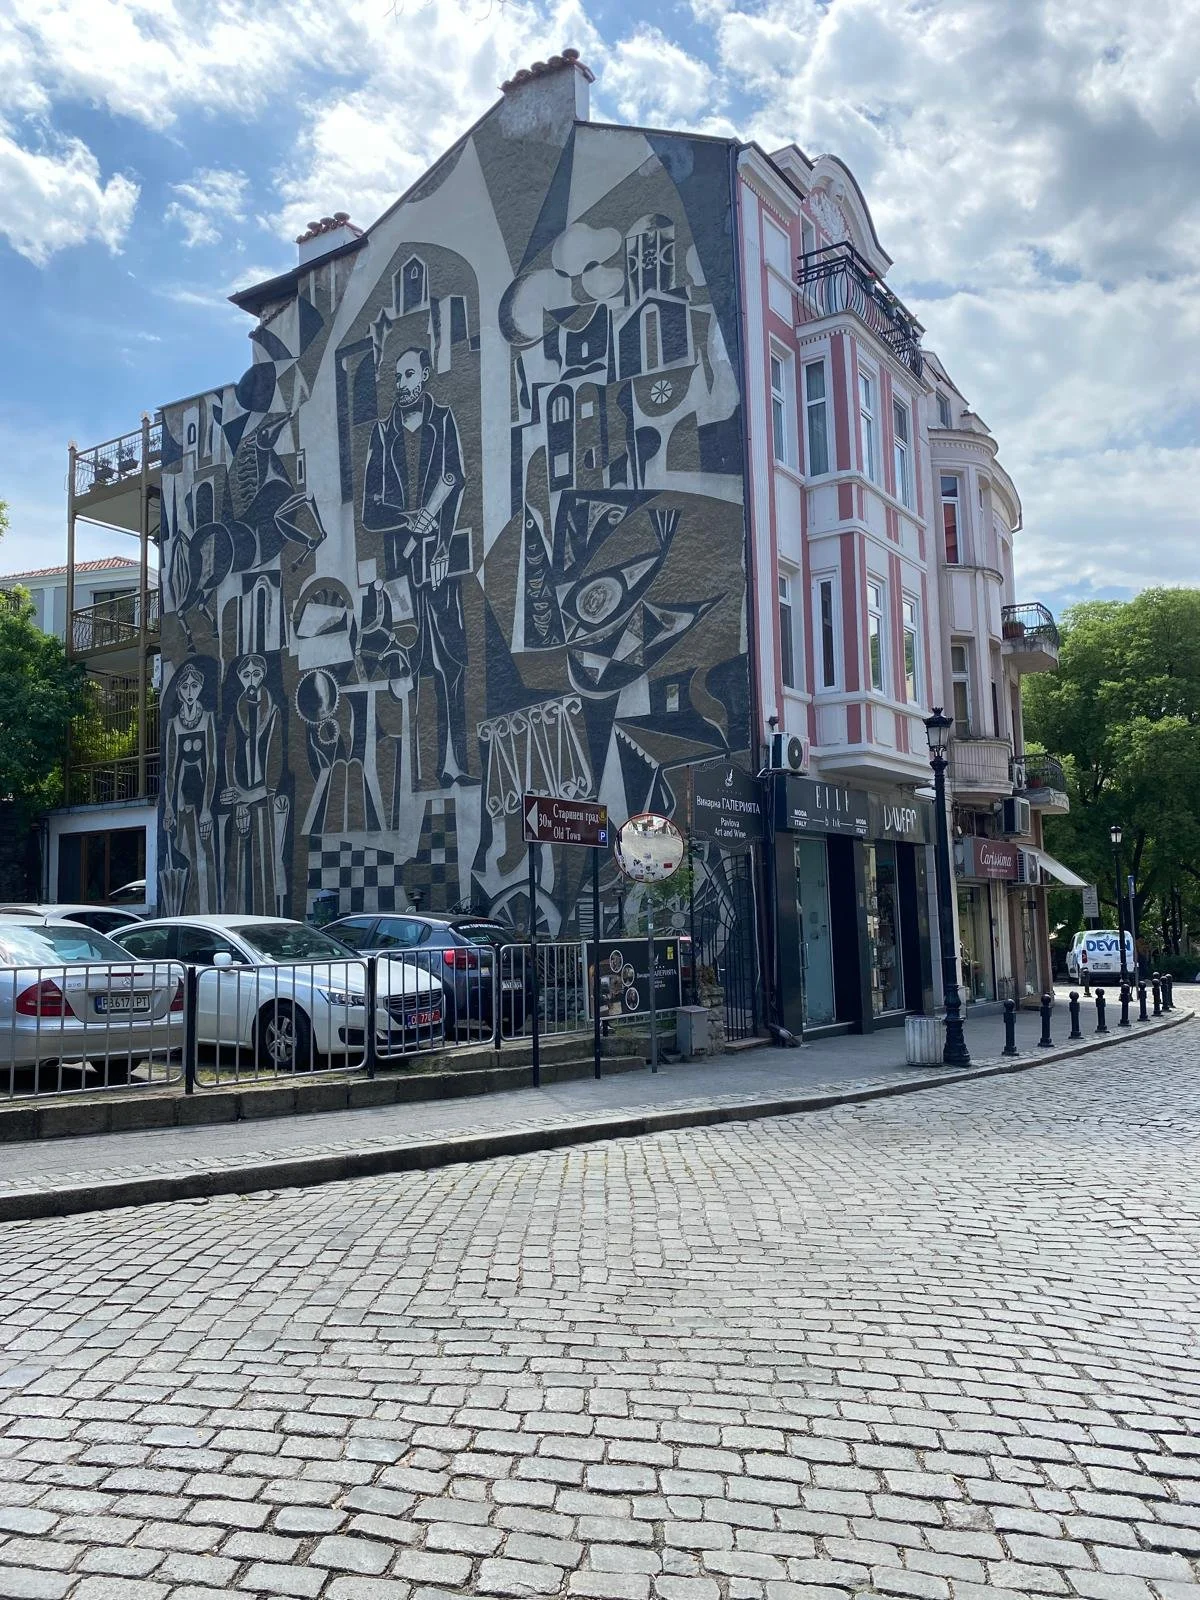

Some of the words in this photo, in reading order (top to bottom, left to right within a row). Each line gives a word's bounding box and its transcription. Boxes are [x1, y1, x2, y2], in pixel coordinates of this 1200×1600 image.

[696, 795, 721, 809] Винарна
[721, 797, 761, 814] ГАЛЕРИЯТА
[552, 803, 584, 822] Старинен
[585, 812, 600, 825] град
[794, 809, 808, 817] MODA
[538, 813, 552, 828] 30м
[720, 817, 740, 828] Pavlova
[794, 819, 808, 828] ITALY
[553, 826, 564, 840] Old
[565, 827, 581, 841] Town
[600, 831, 606, 841] P
[714, 827, 723, 837] Art
[723, 829, 733, 838] and
[733, 829, 747, 839] Wine
[980, 844, 1012, 867] Carissima
[1086, 939, 1131, 952] DEVIN
